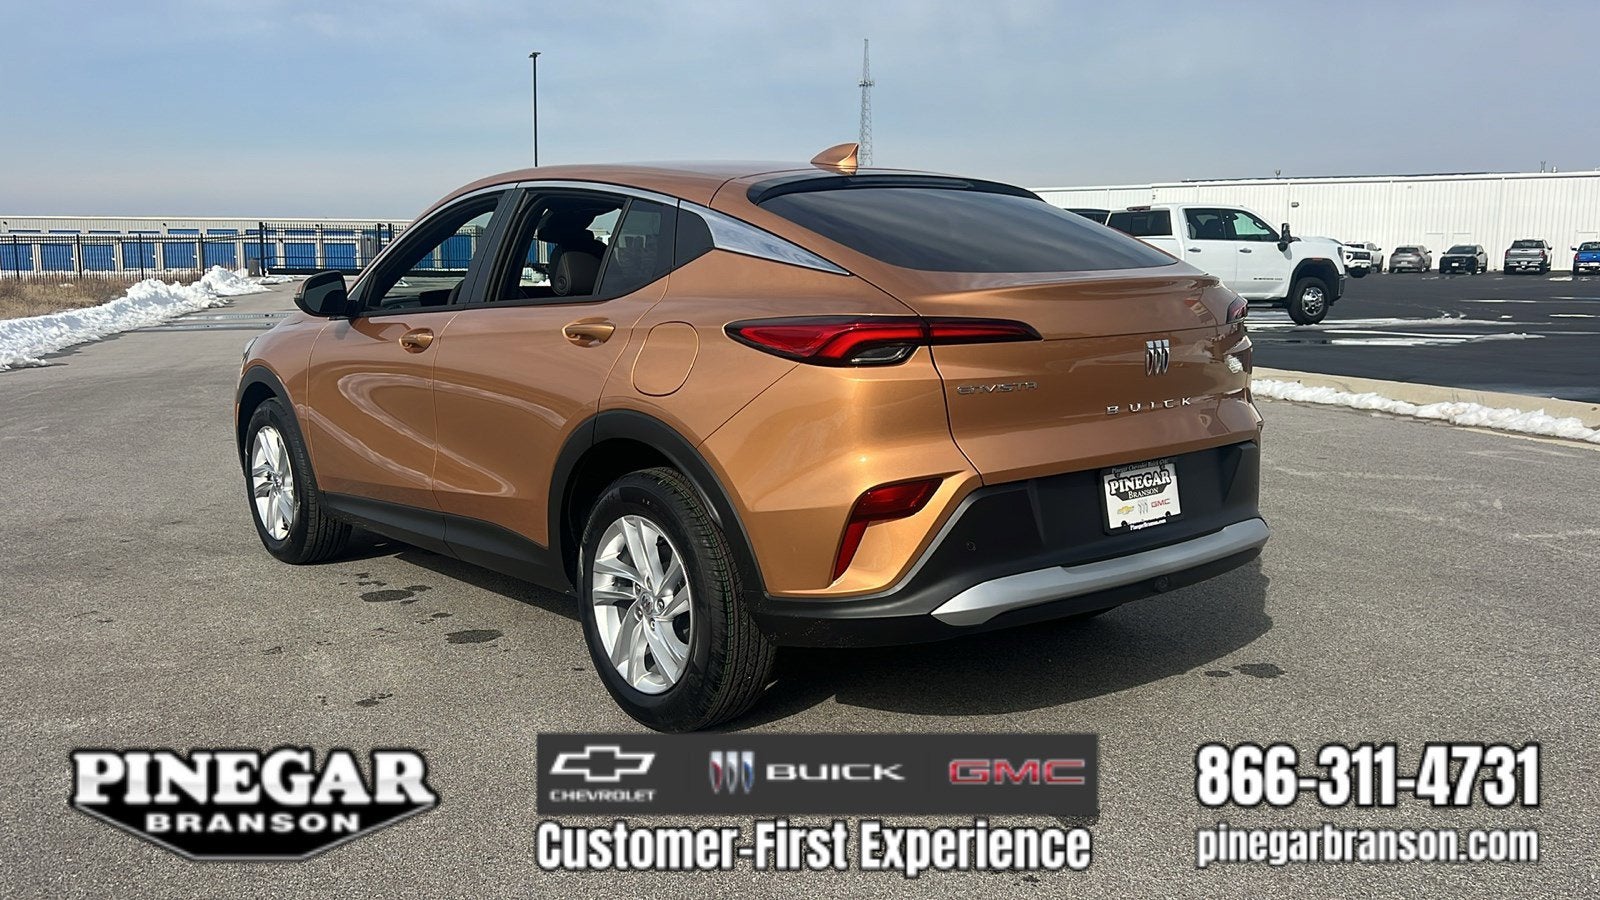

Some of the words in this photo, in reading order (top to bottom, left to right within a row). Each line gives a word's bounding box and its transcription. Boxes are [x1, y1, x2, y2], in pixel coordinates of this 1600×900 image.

[1106, 397, 1192, 415] BUICK
[1109, 470, 1171, 495] PINEGAR
[1151, 498, 1171, 508] GMC
